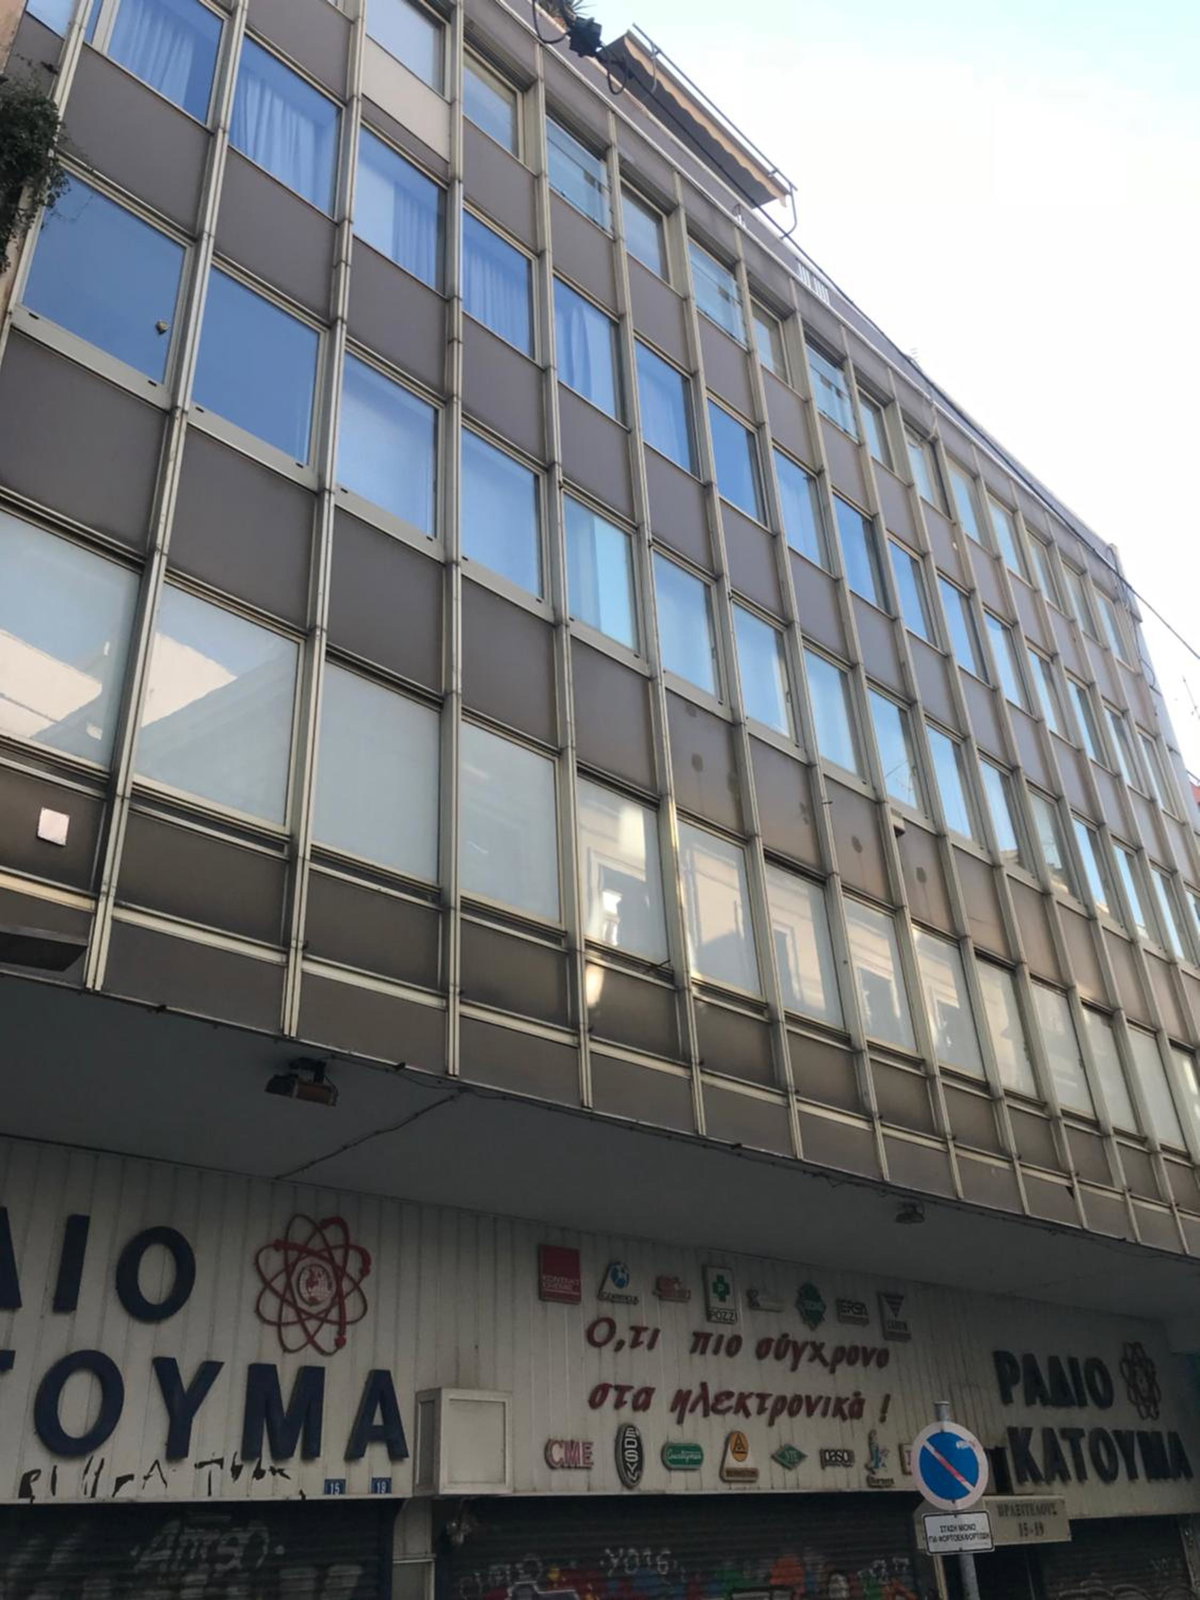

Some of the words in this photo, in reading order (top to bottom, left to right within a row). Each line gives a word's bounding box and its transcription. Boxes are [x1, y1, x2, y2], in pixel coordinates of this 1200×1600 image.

[585, 1316, 660, 1353] Ο,τι
[689, 1330, 743, 1357] πιο
[755, 1332, 891, 1374] σύγχρονο
[0, 1349, 409, 1462] ΟΥΜΑ
[588, 1381, 656, 1412] στα
[670, 1381, 866, 1427] ηλεκτρονικά
[993, 1349, 1114, 1410] ΡΑΔΙΟ
[547, 1439, 594, 1469] CME
[1006, 1426, 1194, 1485] ΚΑΤΟΥΜΑ
[330, 1481, 340, 1495] 15
[376, 1480, 387, 1494] 19
